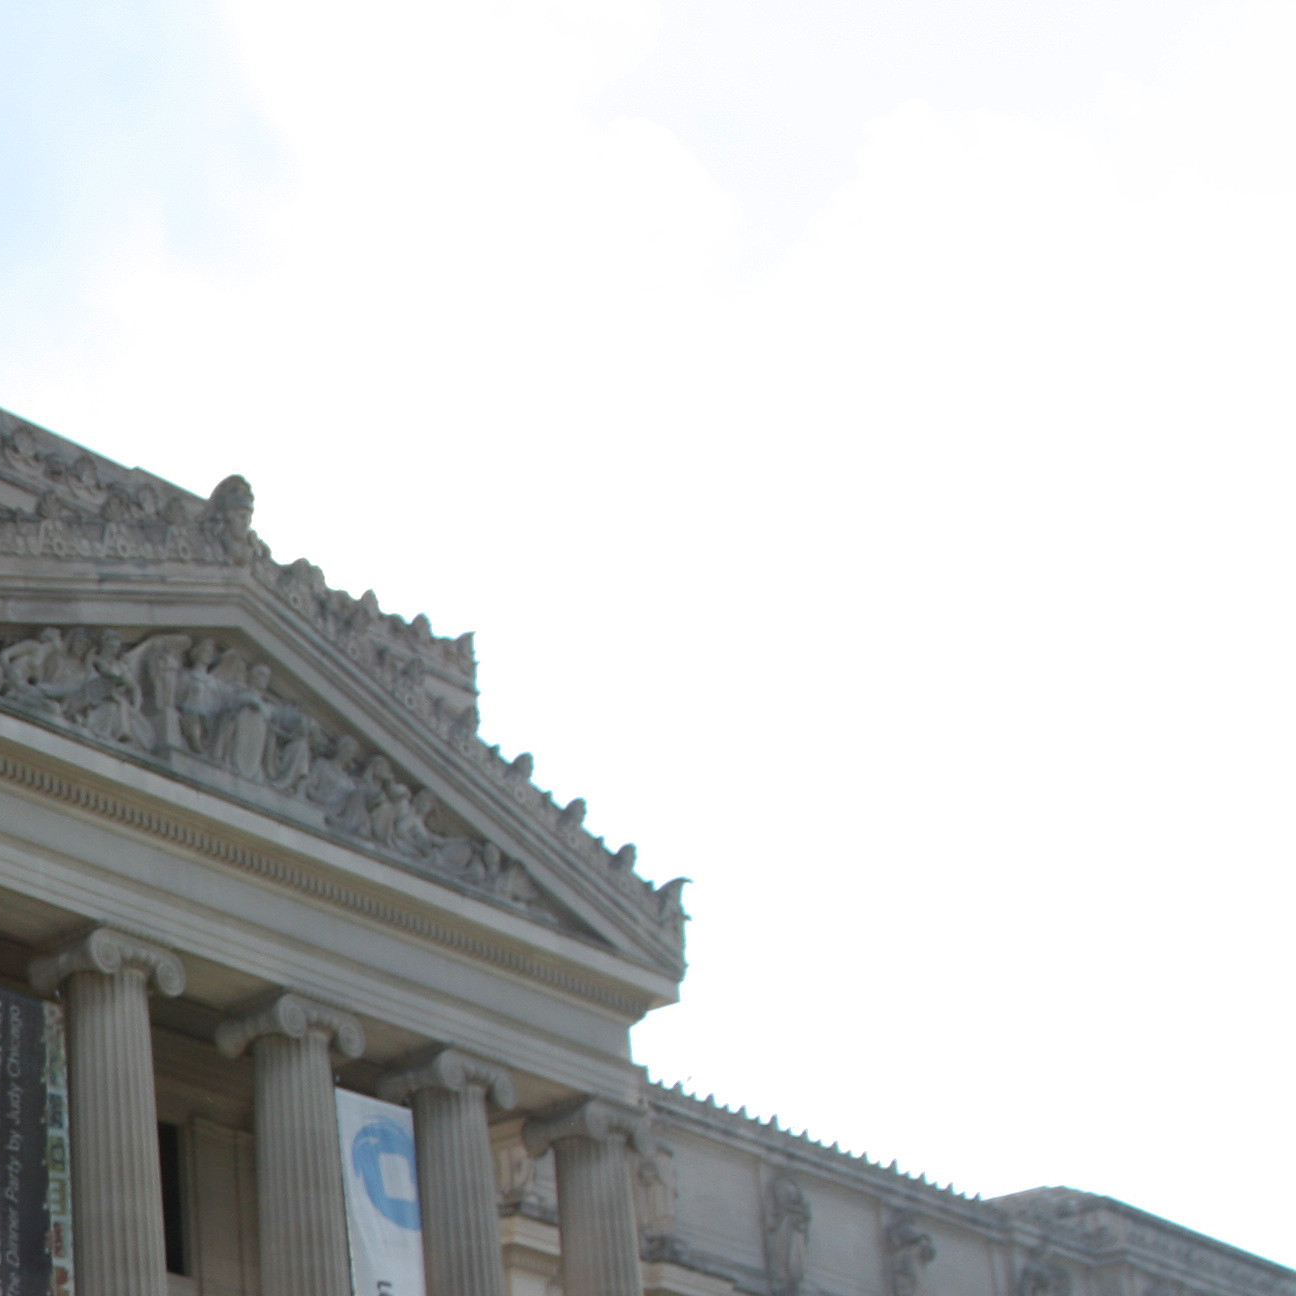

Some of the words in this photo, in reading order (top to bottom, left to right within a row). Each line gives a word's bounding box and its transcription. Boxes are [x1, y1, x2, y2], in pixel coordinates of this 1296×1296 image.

[6, 1004, 24, 1078] Chicago
[6, 1083, 24, 1125] Judy
[6, 1130, 22, 1151] by
[4, 1157, 23, 1204] Party
[5, 1207, 21, 1269] Dinner
